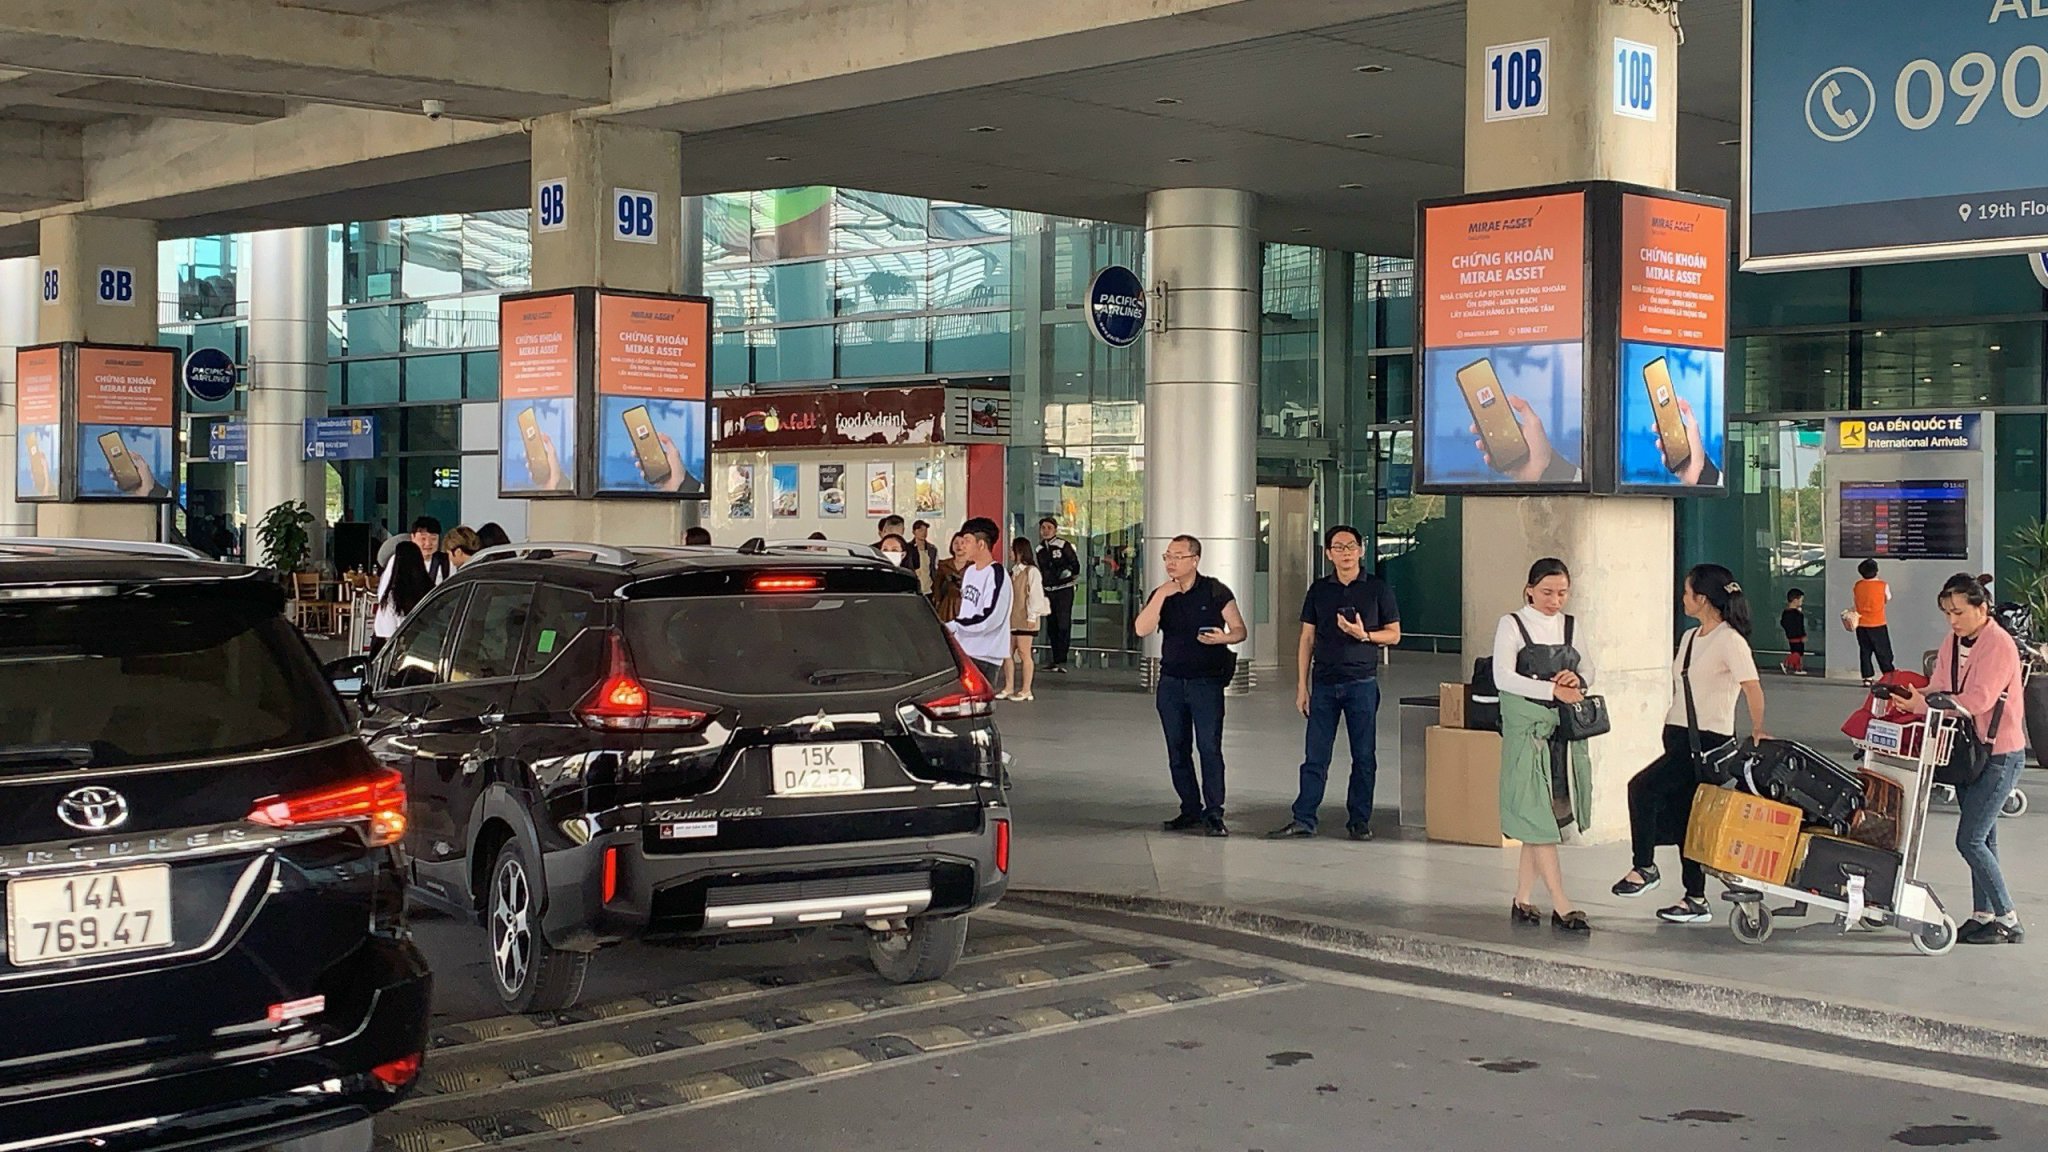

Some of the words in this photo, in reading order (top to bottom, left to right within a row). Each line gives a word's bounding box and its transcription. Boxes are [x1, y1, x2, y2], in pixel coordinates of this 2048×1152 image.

[1492, 48, 1542, 112] 10B
[1618, 49, 1652, 110] 10B
[1894, 44, 2048, 130] 090
[541, 184, 564, 226] 9B
[1979, 203, 2016, 220] 19th
[2024, 200, 2048, 216] Flo
[619, 196, 652, 236] 9B
[1468, 220, 1500, 233] MIRAE
[1502, 218, 1534, 230] ASSET
[1652, 217, 1673, 230] MIRAE
[1452, 251, 1501, 269] CHỨNG
[1504, 246, 1554, 262] KHOÁN
[1640, 246, 1674, 264] CHỨNG
[1675, 252, 1706, 269] KHOÁN
[100, 269, 132, 302] 8B
[1460, 270, 1502, 285] MIRAE
[1506, 266, 1546, 282] ASSET
[1646, 266, 1674, 282] MIRAE
[1676, 270, 1702, 286] ASSET
[44, 270, 58, 302] 8B
[1100, 294, 1137, 308] PACIFIC
[1100, 304, 1142, 319] AIRLINES
[619, 331, 654, 343] CHỨNG
[656, 334, 688, 346] KHOÁN
[625, 344, 654, 355] MIRAE
[656, 346, 683, 357] ASSET
[1868, 420, 1884, 432] GA
[1886, 416, 1910, 431] ĐẾN
[1912, 416, 1946, 432] QUỐC
[1948, 415, 1963, 430] TẾ
[1868, 436, 1928, 448] International
[1930, 436, 1968, 448] Arrivals
[802, 746, 835, 766] 15K
[64, 875, 128, 913] 14A
[32, 910, 152, 956] 769.47
